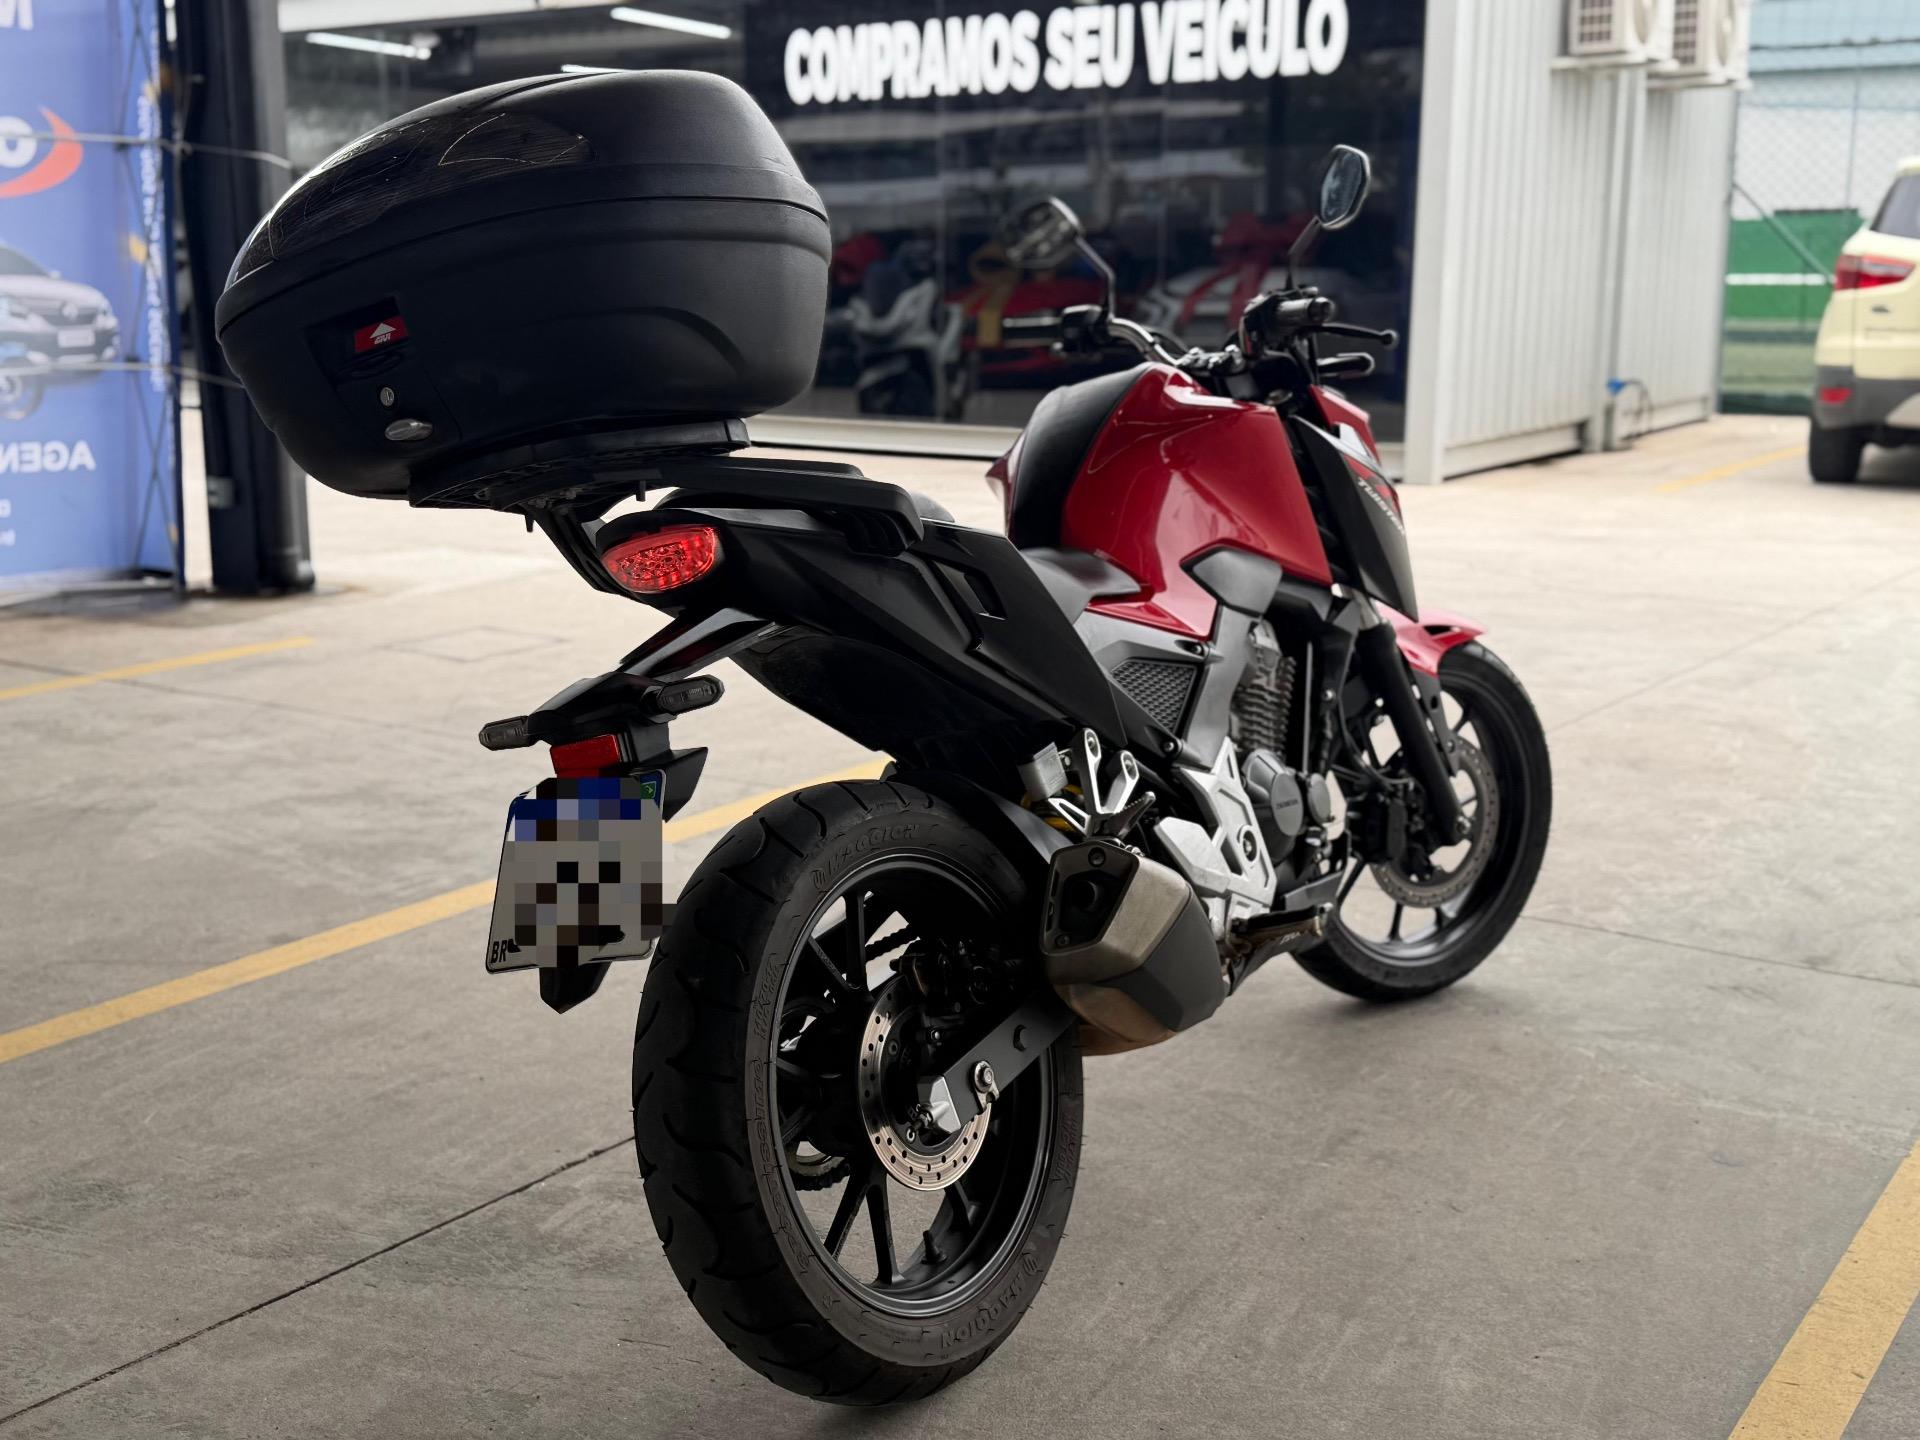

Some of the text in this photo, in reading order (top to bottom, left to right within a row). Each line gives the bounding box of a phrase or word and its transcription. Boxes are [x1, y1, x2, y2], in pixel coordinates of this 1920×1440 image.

[784, 11, 1041, 106] COMPRAMOS
[1044, 4, 1135, 90] SEU
[490, 939, 508, 963] BR
